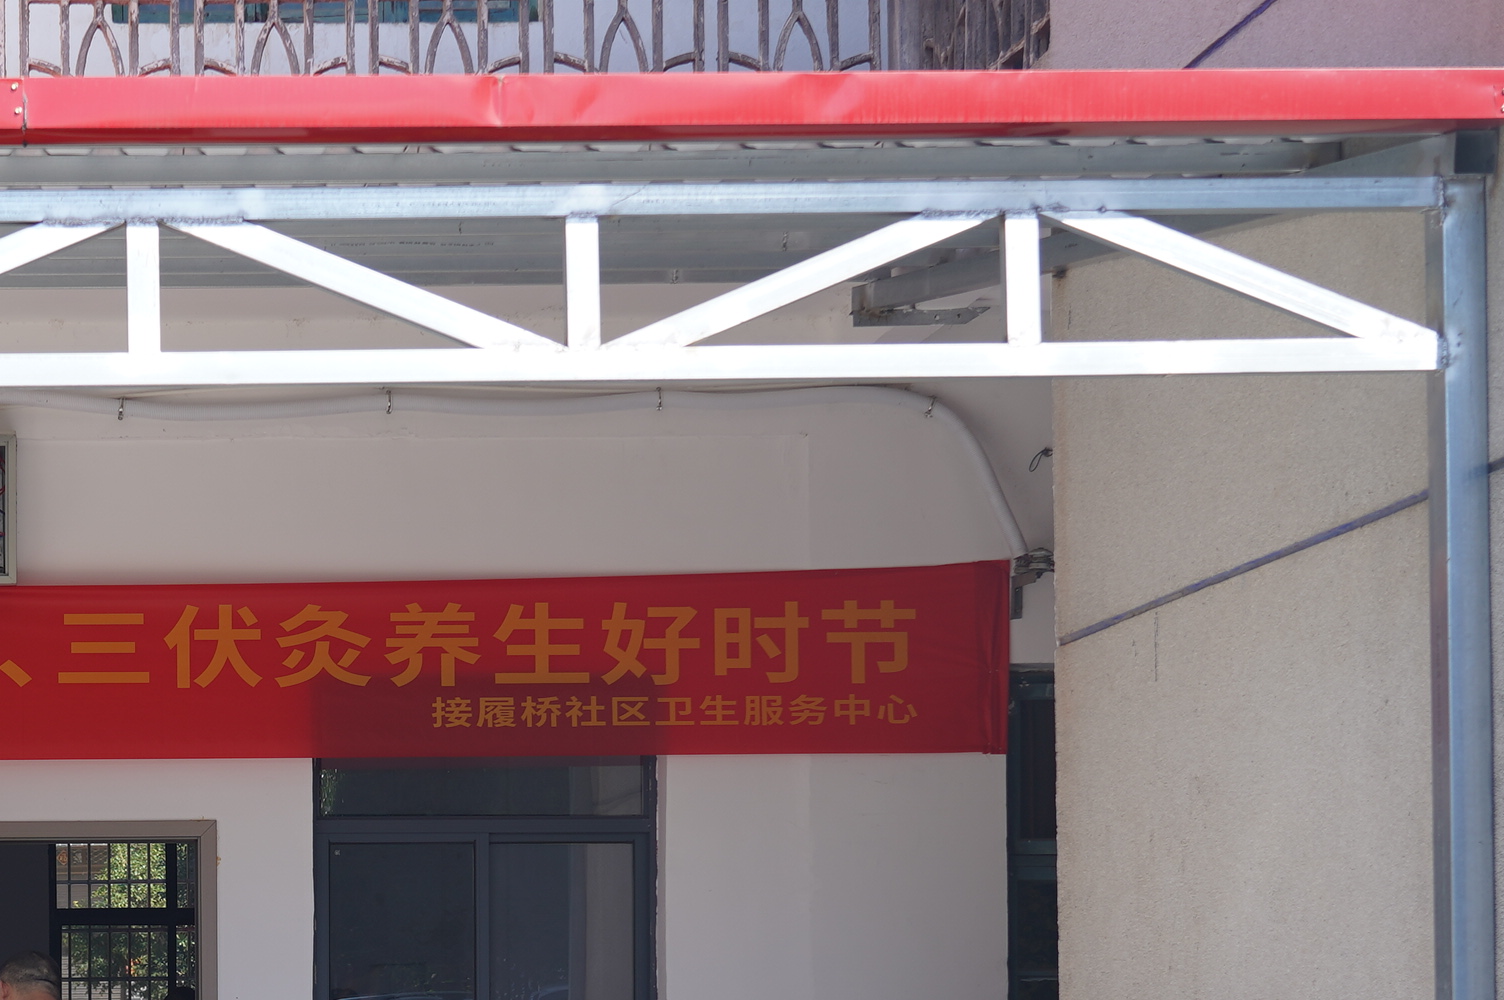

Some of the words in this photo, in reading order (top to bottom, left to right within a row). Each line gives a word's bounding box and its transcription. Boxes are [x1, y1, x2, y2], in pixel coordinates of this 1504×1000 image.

[431, 694, 918, 728] 接履桥社区卫生服务中心
